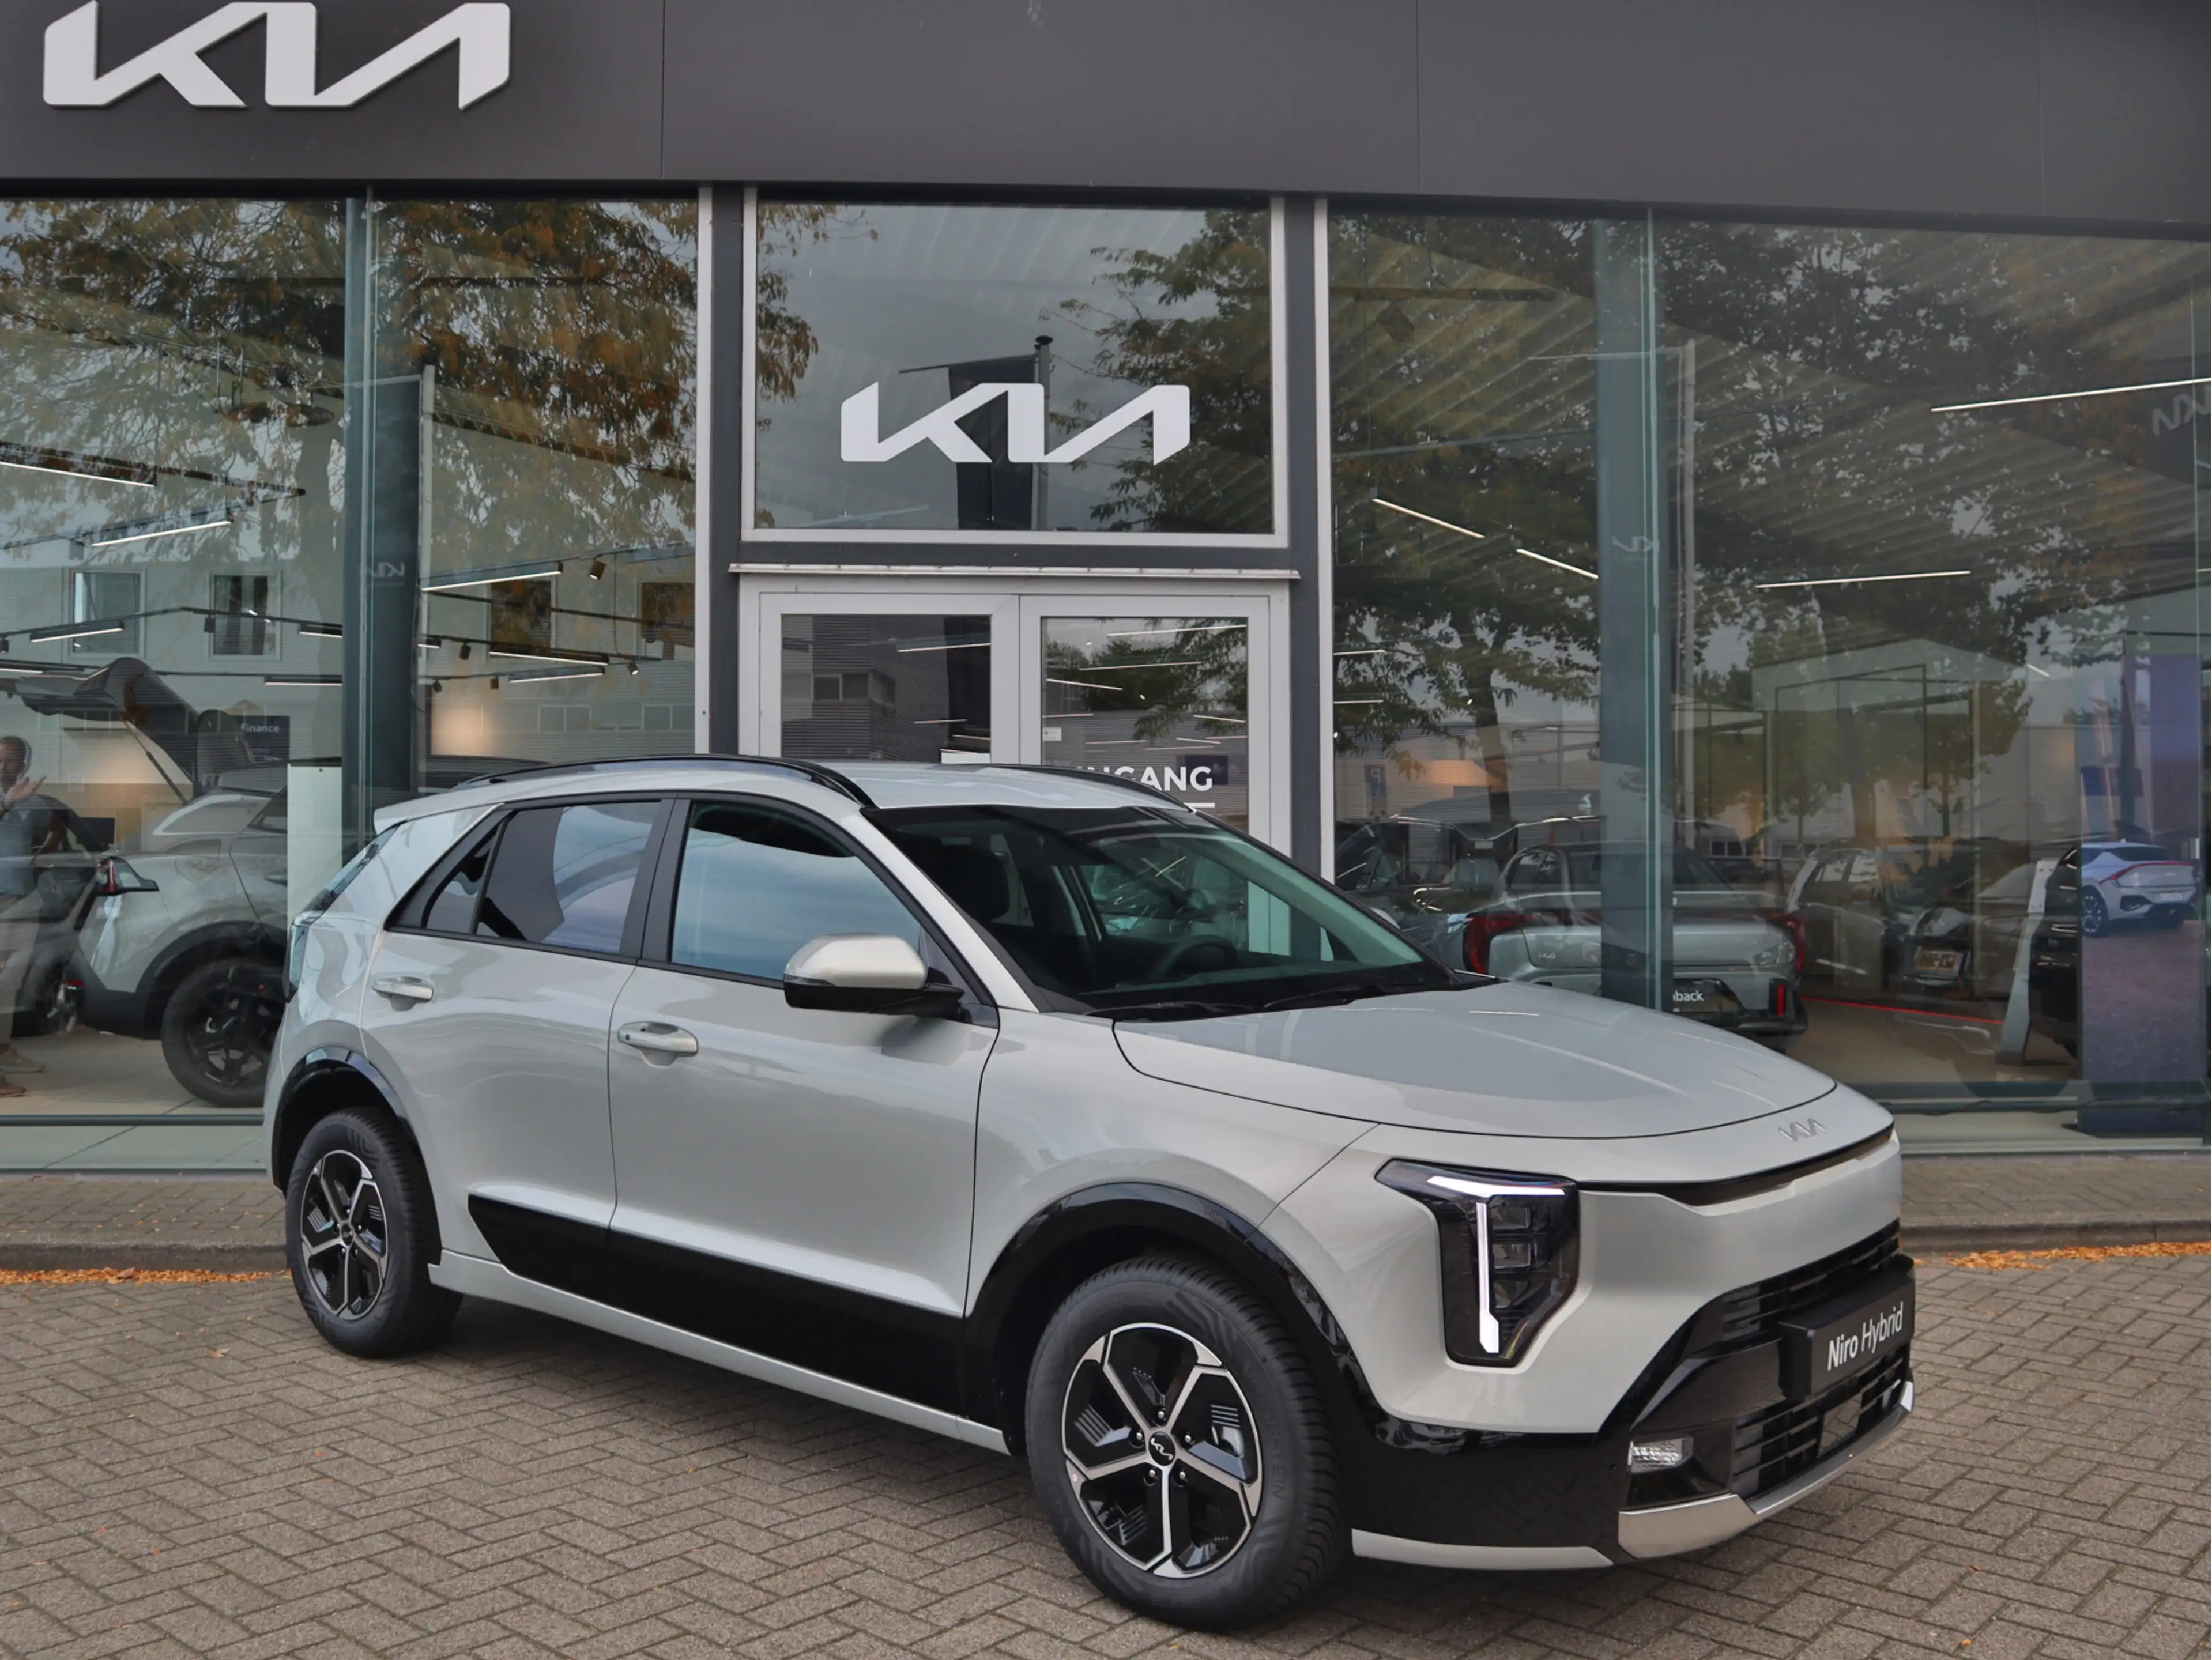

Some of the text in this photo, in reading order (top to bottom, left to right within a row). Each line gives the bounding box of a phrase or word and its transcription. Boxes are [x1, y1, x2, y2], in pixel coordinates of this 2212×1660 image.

[43, 0, 510, 110] KIA
[841, 381, 1190, 466] KIA
[240, 723, 280, 733] Finance
[1827, 1301, 1904, 1371] Niro Hybrid
